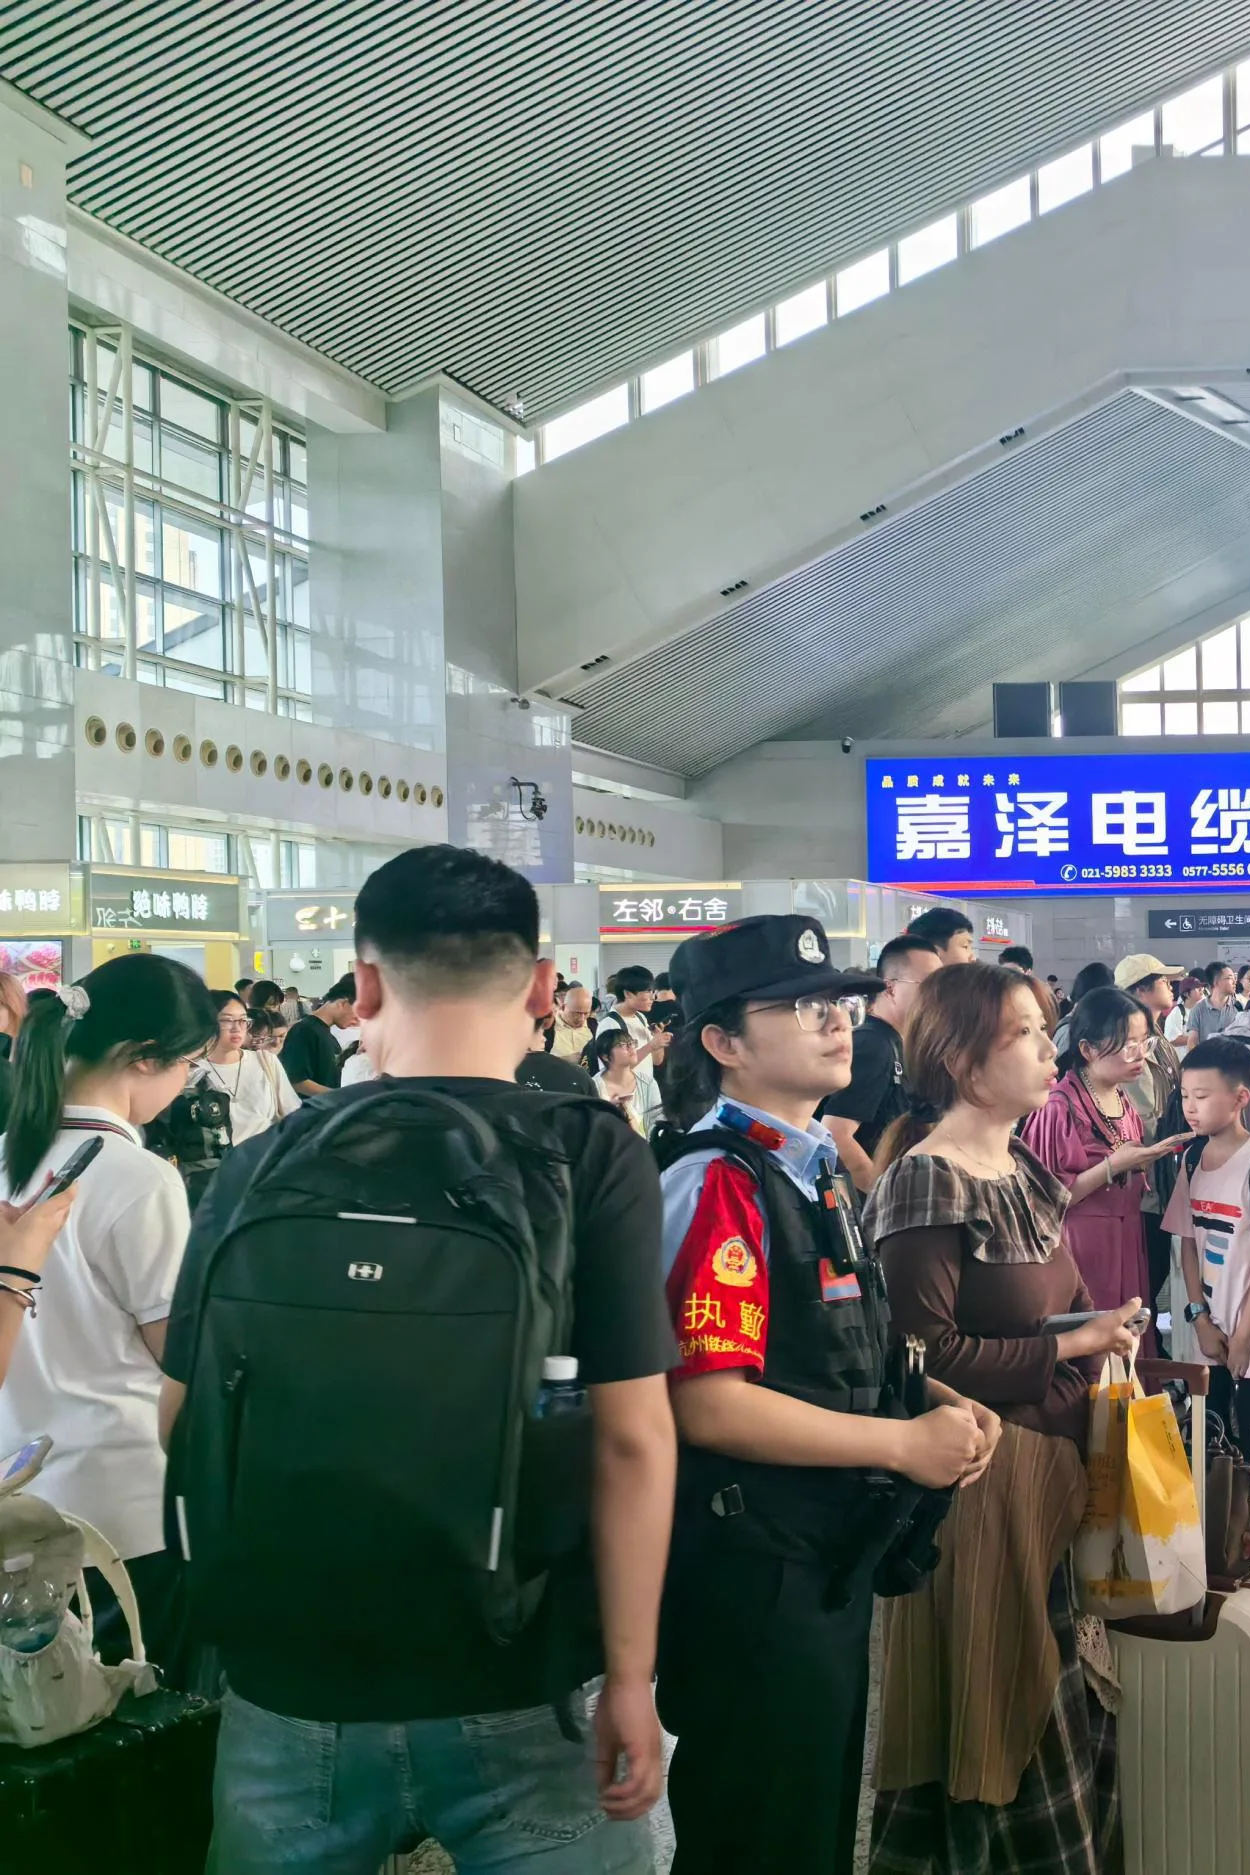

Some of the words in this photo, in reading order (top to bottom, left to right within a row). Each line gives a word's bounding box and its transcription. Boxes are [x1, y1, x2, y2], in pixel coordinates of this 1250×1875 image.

[1081, 865, 1137, 878] 021-5983
[1140, 864, 1172, 877] 3333
[1183, 863, 1244, 876] 0577-5556
[132, 888, 209, 920] 绝味鸭脖
[685, 1292, 766, 1341] 执勤
